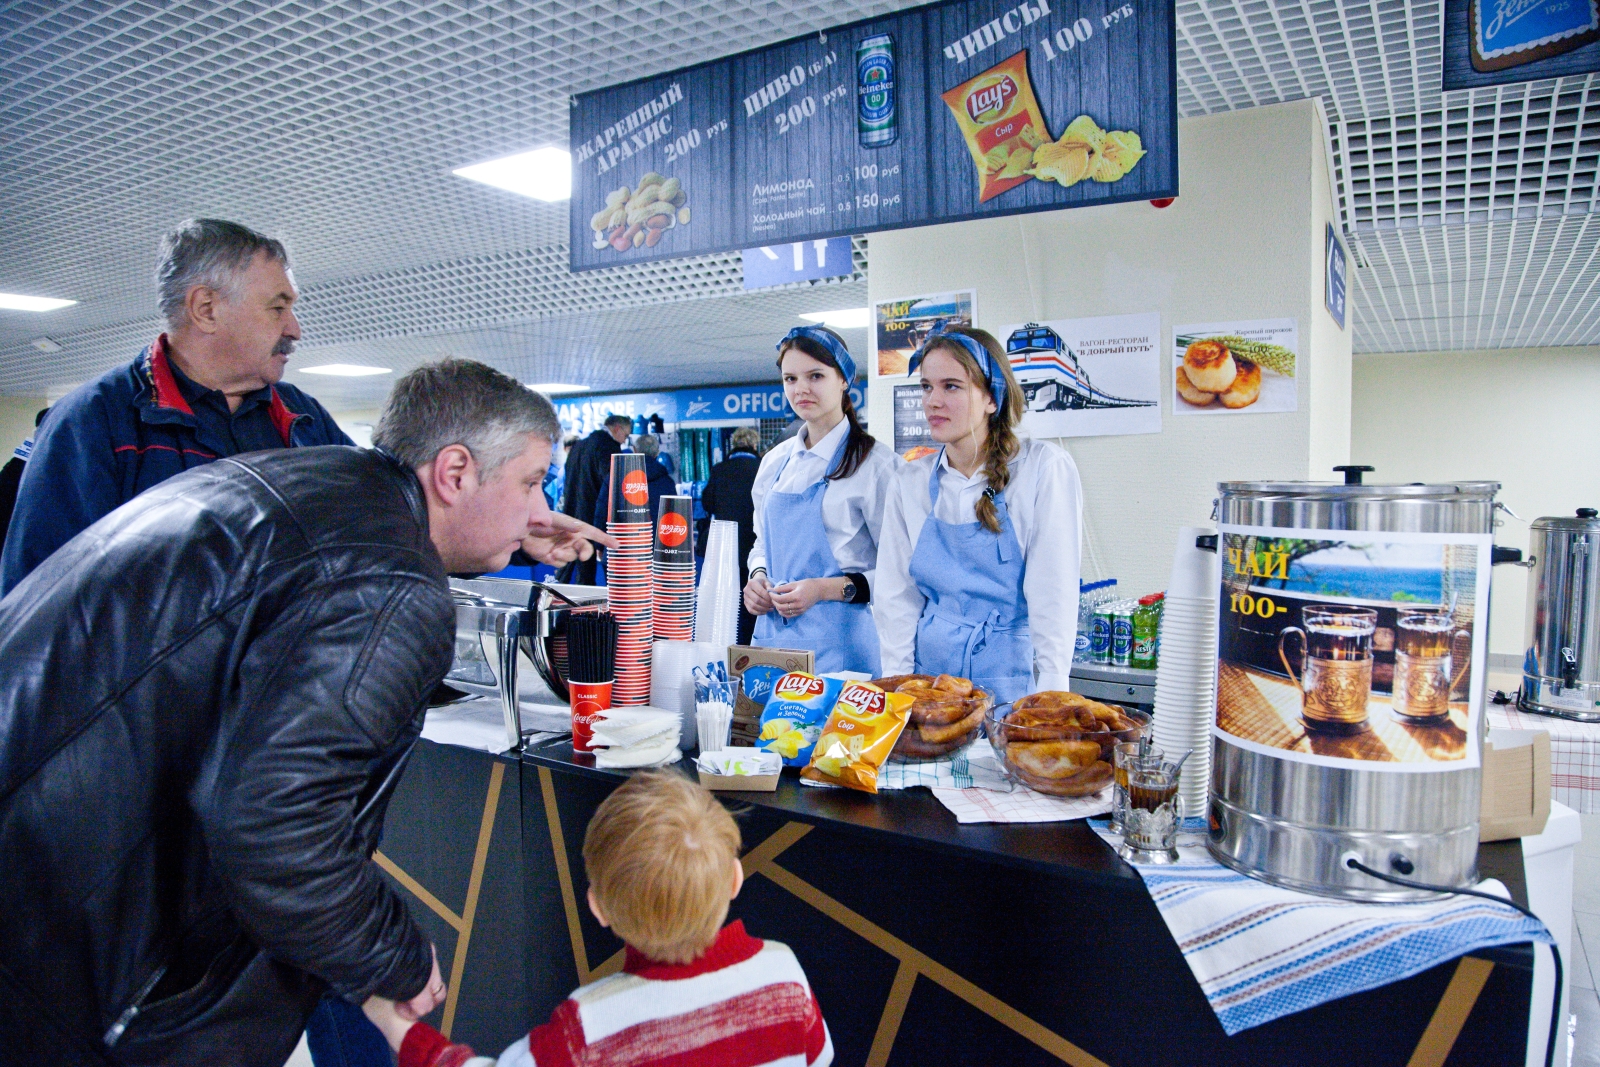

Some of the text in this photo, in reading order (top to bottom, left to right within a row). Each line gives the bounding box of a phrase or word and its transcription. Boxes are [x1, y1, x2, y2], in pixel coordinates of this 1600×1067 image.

[1545, 2, 1571, 15] 1925
[943, 0, 1052, 64] ЧИПСЫ
[1040, 3, 1134, 62] 100 РУБ
[743, 65, 805, 118] ПИВО
[808, 51, 837, 77] (Б/А)
[970, 77, 1012, 118] Lay's
[775, 84, 847, 134] 200 РУБ
[575, 81, 684, 165] ЖАРЕННЫЙ
[995, 123, 1013, 138] Сыр
[597, 114, 673, 176] АРАХИС
[664, 119, 728, 164] 200 РУБ
[752, 178, 815, 197] Лимонад
[854, 164, 878, 180] 100
[881, 165, 900, 178] руб
[752, 193, 901, 224] Холодный чай 0.5 150 руб
[881, 303, 909, 318] ЧАЙ
[1080, 336, 1149, 347] ВАГОН-РЕСТОРАН
[1234, 328, 1264, 336] Жареный
[1087, 345, 1124, 356] ДОБРЫЙ
[1126, 344, 1154, 353] ПУТЬ"
[723, 391, 788, 414] OFFICI
[902, 426, 923, 436] 200
[1227, 544, 1290, 580] ЧАЙ
[1230, 592, 1288, 619] 100-
[748, 678, 771, 700] Зен
[777, 674, 822, 696] Lay's
[779, 703, 808, 714] Сметана
[838, 684, 884, 715] Lay's
[837, 719, 855, 731] Сыр
